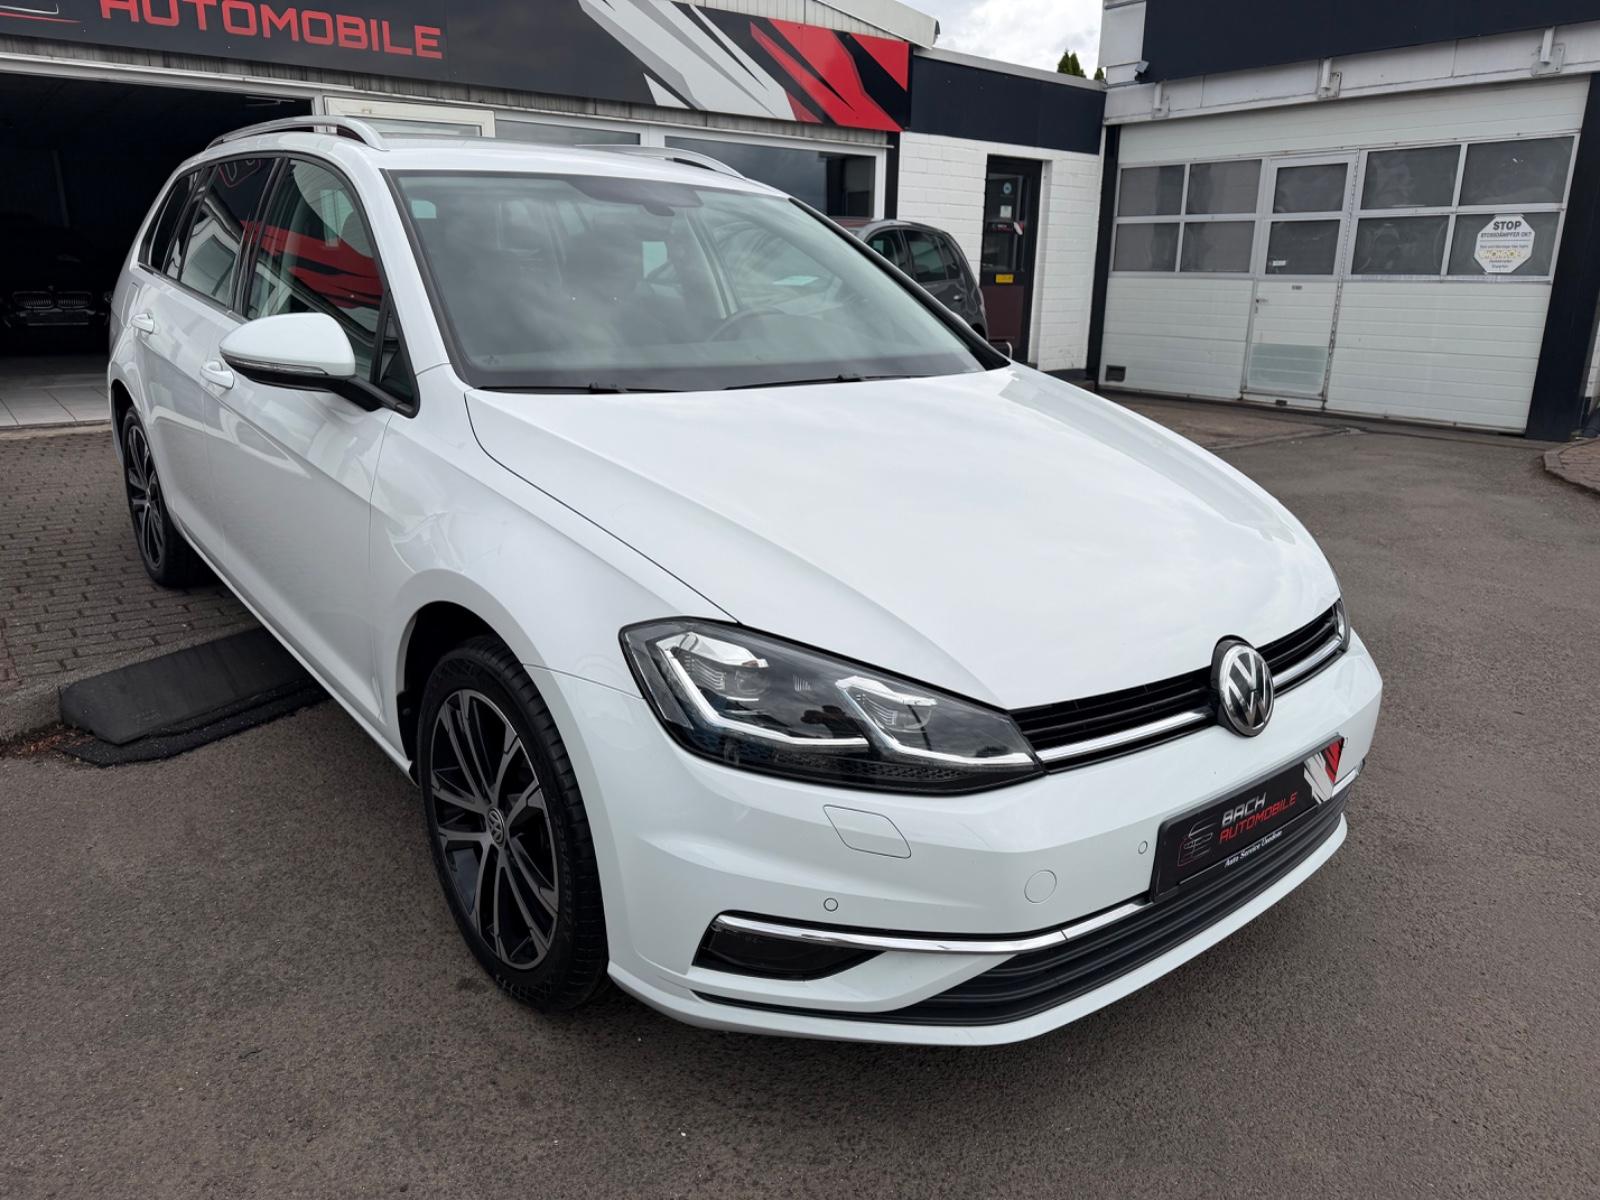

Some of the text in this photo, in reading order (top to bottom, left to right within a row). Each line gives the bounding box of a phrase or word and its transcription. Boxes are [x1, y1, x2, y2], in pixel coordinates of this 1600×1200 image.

[100, 0, 443, 60] AUTOMOBILE
[1493, 220, 1522, 231] STOP
[1219, 791, 1298, 844] AUTOMOBILE
[1221, 791, 1267, 827] BACH
